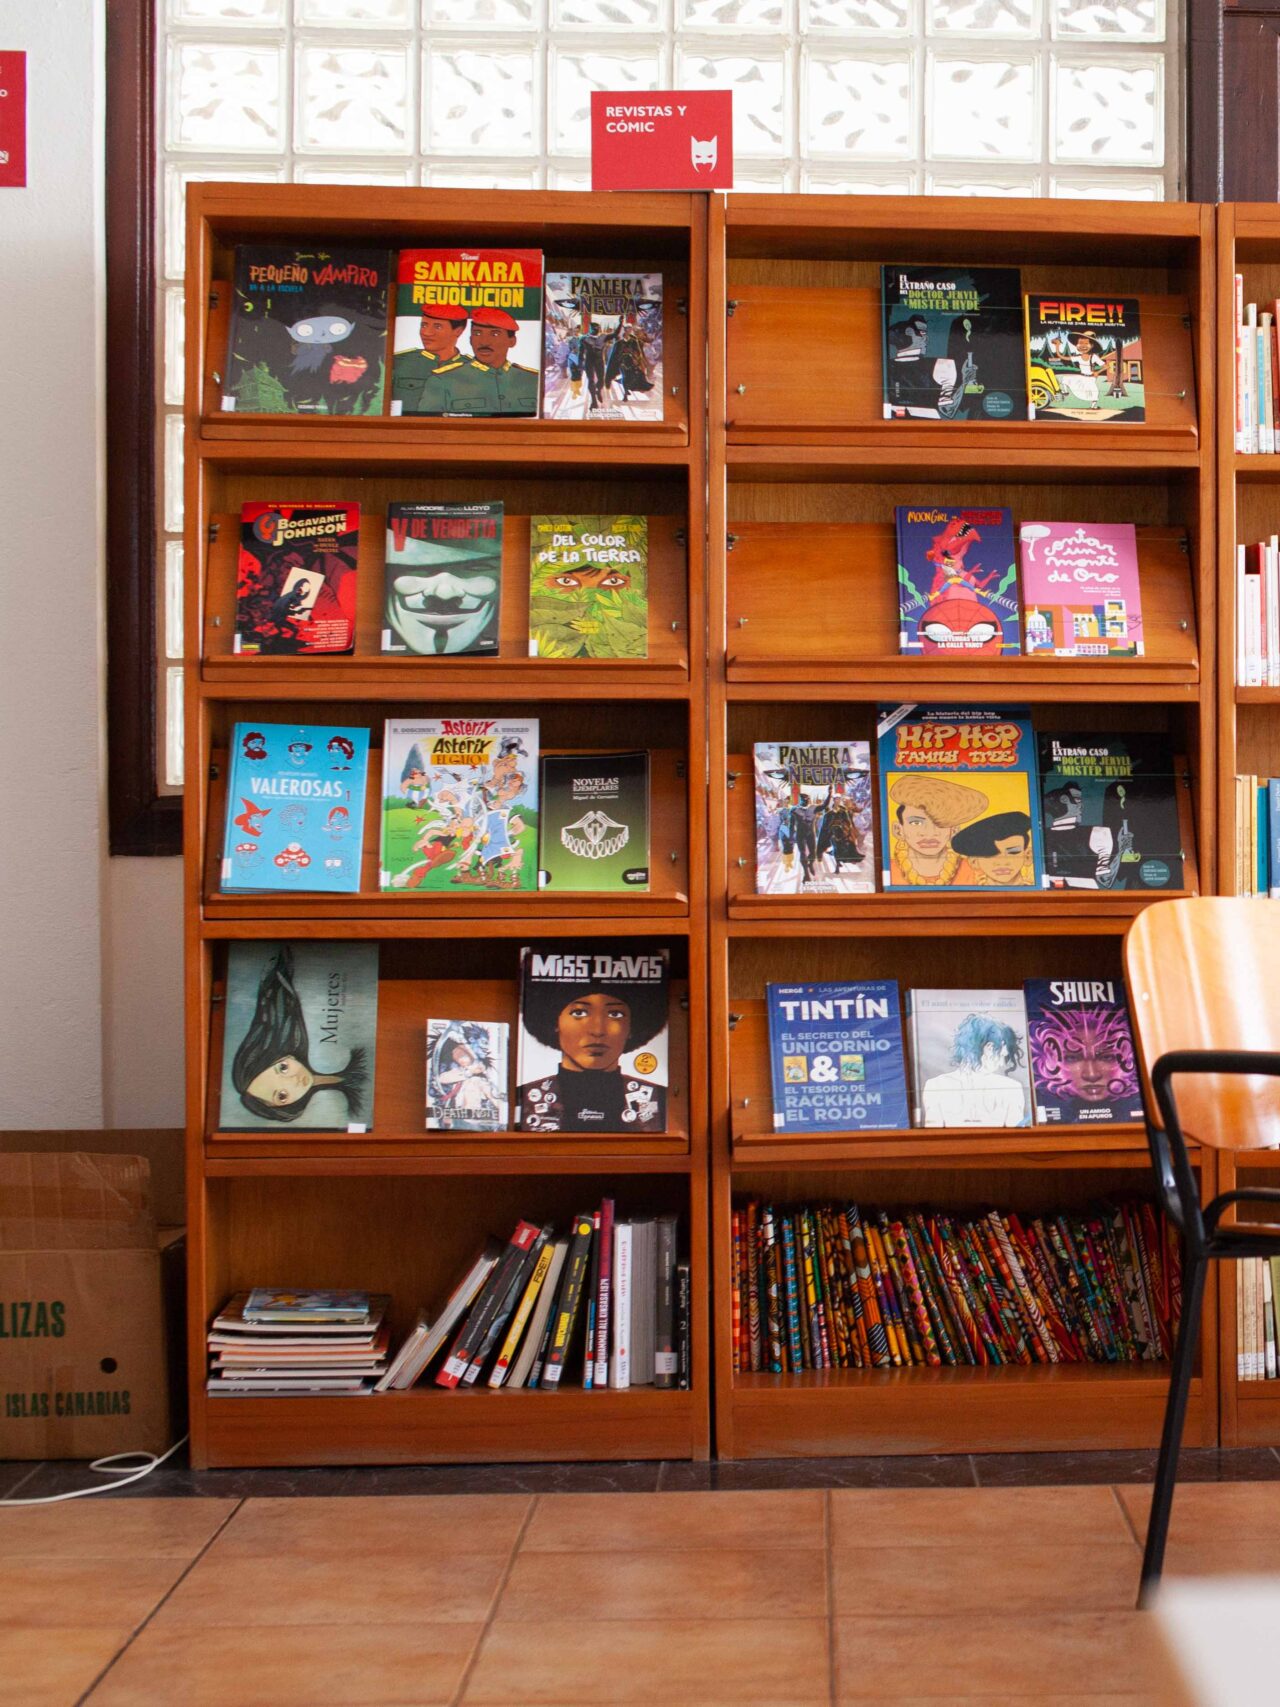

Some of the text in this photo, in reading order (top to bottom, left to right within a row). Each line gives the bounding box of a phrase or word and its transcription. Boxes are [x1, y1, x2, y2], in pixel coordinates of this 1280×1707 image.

[605, 105, 687, 117] REVISTAS Y
[605, 119, 655, 133] CÓMIC
[248, 263, 378, 287] PEQUEÑO VAMPIRO
[413, 261, 525, 282] SANKARA
[570, 276, 644, 295] PANTERA
[899, 281, 956, 291] EXTRAÑO CASO
[908, 290, 944, 299] DOCTOR
[946, 290, 978, 300] JEKYLL
[580, 296, 638, 315] NEGRA
[908, 299, 980, 311] MISTER HYDE
[1039, 302, 1124, 323] FIRE!!
[277, 513, 347, 530] BOGAVANTE
[272, 522, 347, 546] JOHNSON
[391, 518, 497, 552] V DE VENDETTA
[552, 532, 626, 548] DEL COLOR
[538, 547, 641, 563] DE LA TIERRA
[1047, 567, 1120, 583] de Oro
[440, 719, 497, 735] Astérix
[432, 736, 493, 754] Astérix
[1052, 740, 1060, 748] EL
[1052, 747, 1109, 756] EXTRAÑO CASO
[779, 746, 852, 765] PANTERA
[896, 750, 960, 764] FAMILY
[1061, 756, 1097, 765] DOCTOR
[1099, 756, 1131, 765] JEKYLL
[788, 765, 846, 785] NEGRA
[1062, 765, 1133, 776] MISTER HYDE
[251, 777, 343, 798] VALEROSAS
[573, 777, 619, 786] NOVELAS
[573, 784, 619, 792] EJEMPLARES
[531, 954, 663, 979] MISS DAVIS
[834, 985, 876, 993] AVENTURAS
[1049, 981, 1115, 1005] SHURI
[319, 971, 345, 1045] Mujeres
[779, 993, 889, 1021] TINTÍN
[781, 1030, 874, 1041] EL SECRETO DEL
[781, 1039, 891, 1054] UNICORNIO
[809, 1055, 839, 1083] &
[784, 1084, 866, 1094] EL TESORO DE
[785, 1093, 882, 1108] RACKHAM
[786, 1107, 867, 1122] EL ROJO
[600, 1278, 609, 1292] 1974
[6, 1390, 131, 1418] ISLAS CANARIAS
